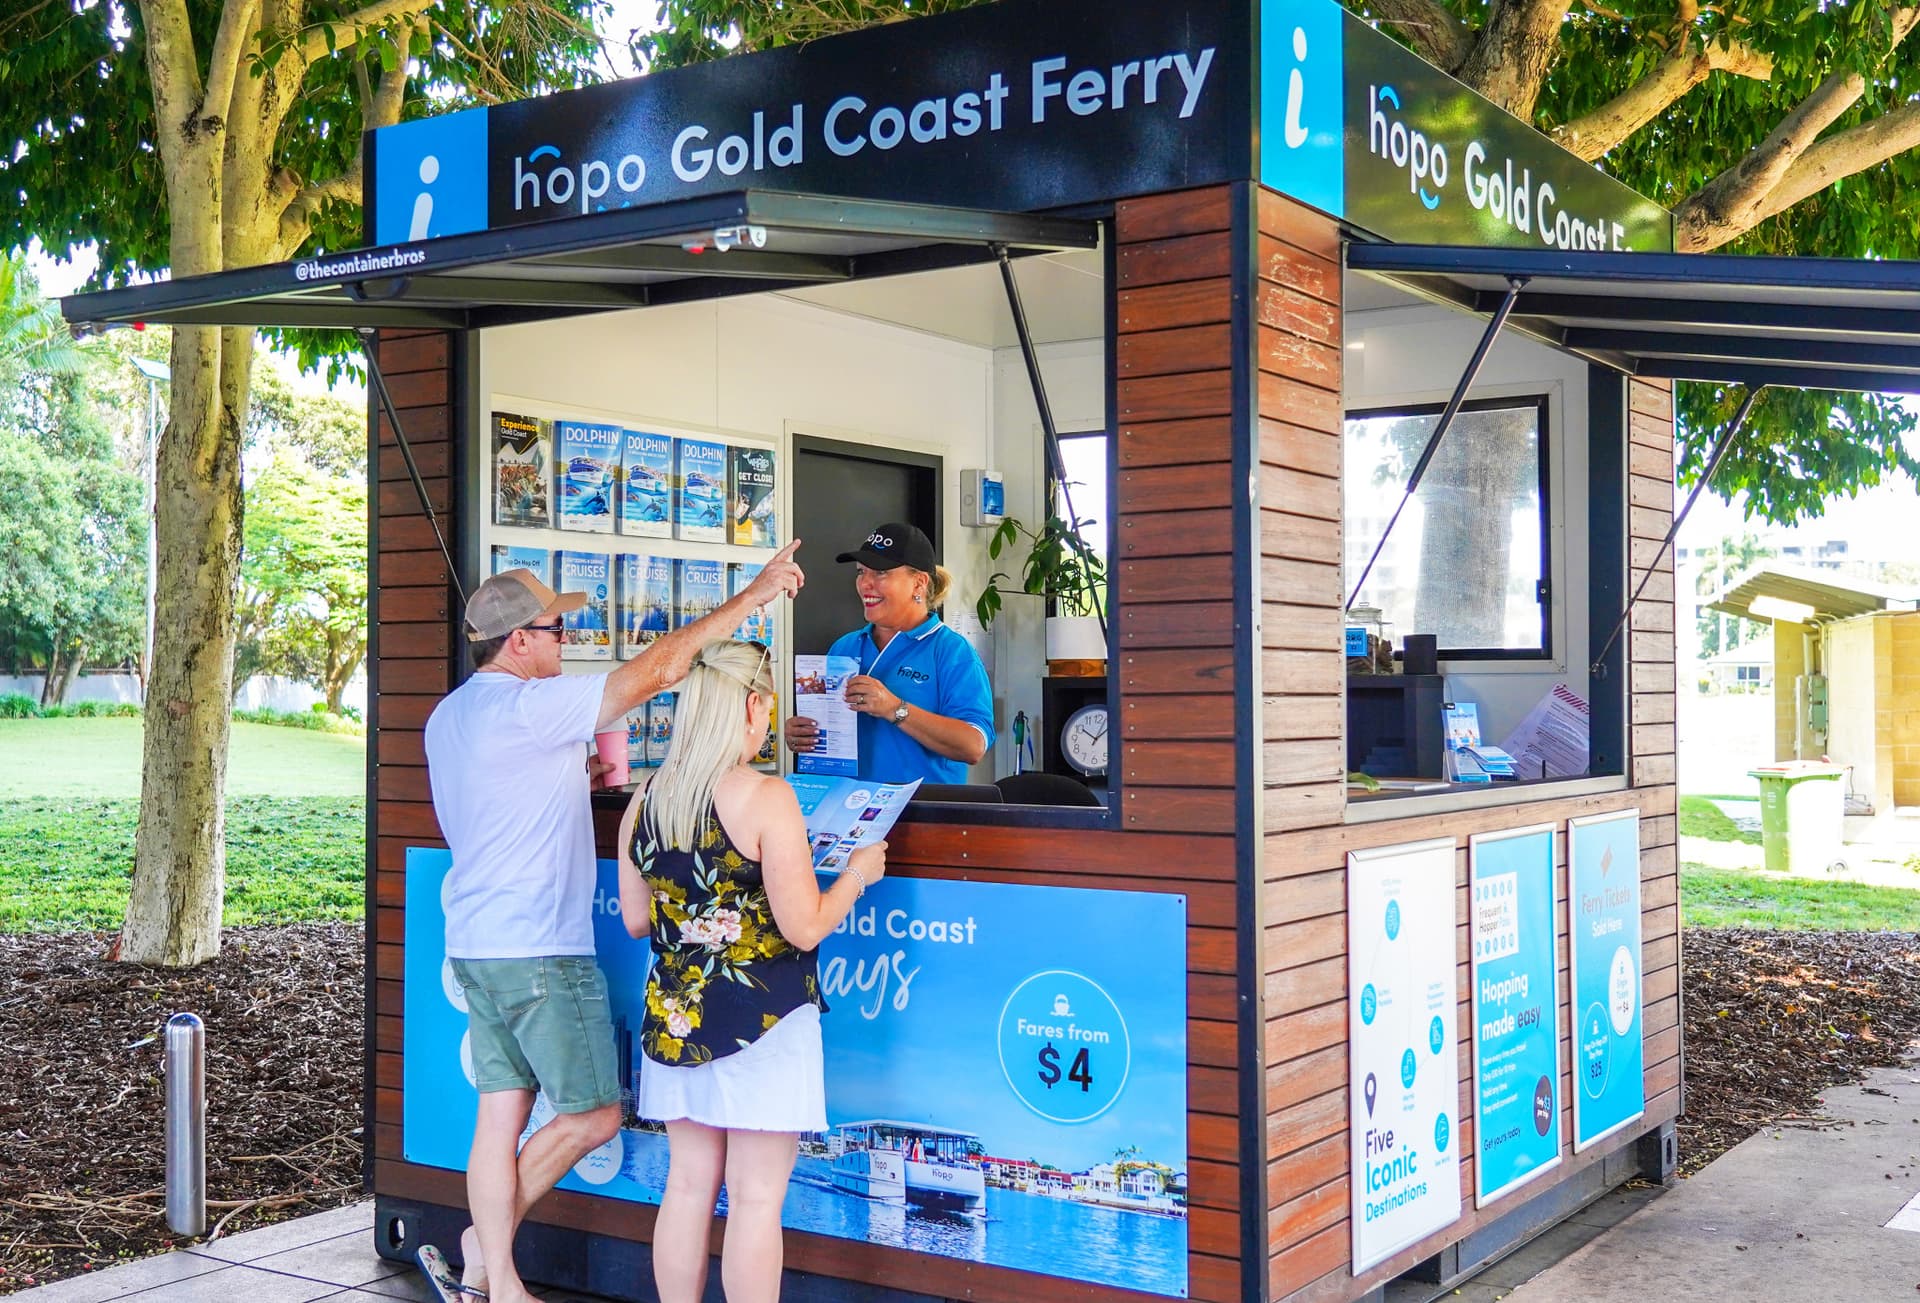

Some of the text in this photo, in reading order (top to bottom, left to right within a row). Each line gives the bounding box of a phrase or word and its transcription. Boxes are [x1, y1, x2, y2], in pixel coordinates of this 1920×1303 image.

[515, 48, 1215, 214] hopo Gold Coast Ferry
[1370, 85, 1607, 251] hopo Gold Coast
[295, 248, 426, 281] @thecontainerbros
[566, 427, 619, 444] DOLPHIN
[627, 436, 668, 453] DOLPHIN
[684, 444, 722, 461] DOLPHIN
[866, 533, 893, 547] opo
[563, 564, 606, 578] CRUISES
[629, 566, 668, 581] CRUISES
[897, 666, 930, 682] hopo
[1094, 714, 1104, 725] 12
[1072, 734, 1078, 743] 9
[1073, 744, 1080, 754] 8
[1091, 755, 1098, 765] 6
[593, 888, 621, 916] Ho
[886, 909, 977, 944] Coast
[1582, 894, 1603, 917] Ferry
[820, 950, 922, 1020] ays
[1482, 970, 1528, 1006] Hopping
[1017, 1018, 1110, 1044] Fares from
[1482, 1005, 1541, 1041] made easy
[1038, 1042, 1093, 1092] $4
[1366, 1128, 1394, 1158] Five
[932, 1168, 953, 1181] hopo
[1366, 1144, 1417, 1194] Iconic
[1366, 1182, 1427, 1222] Destinations
